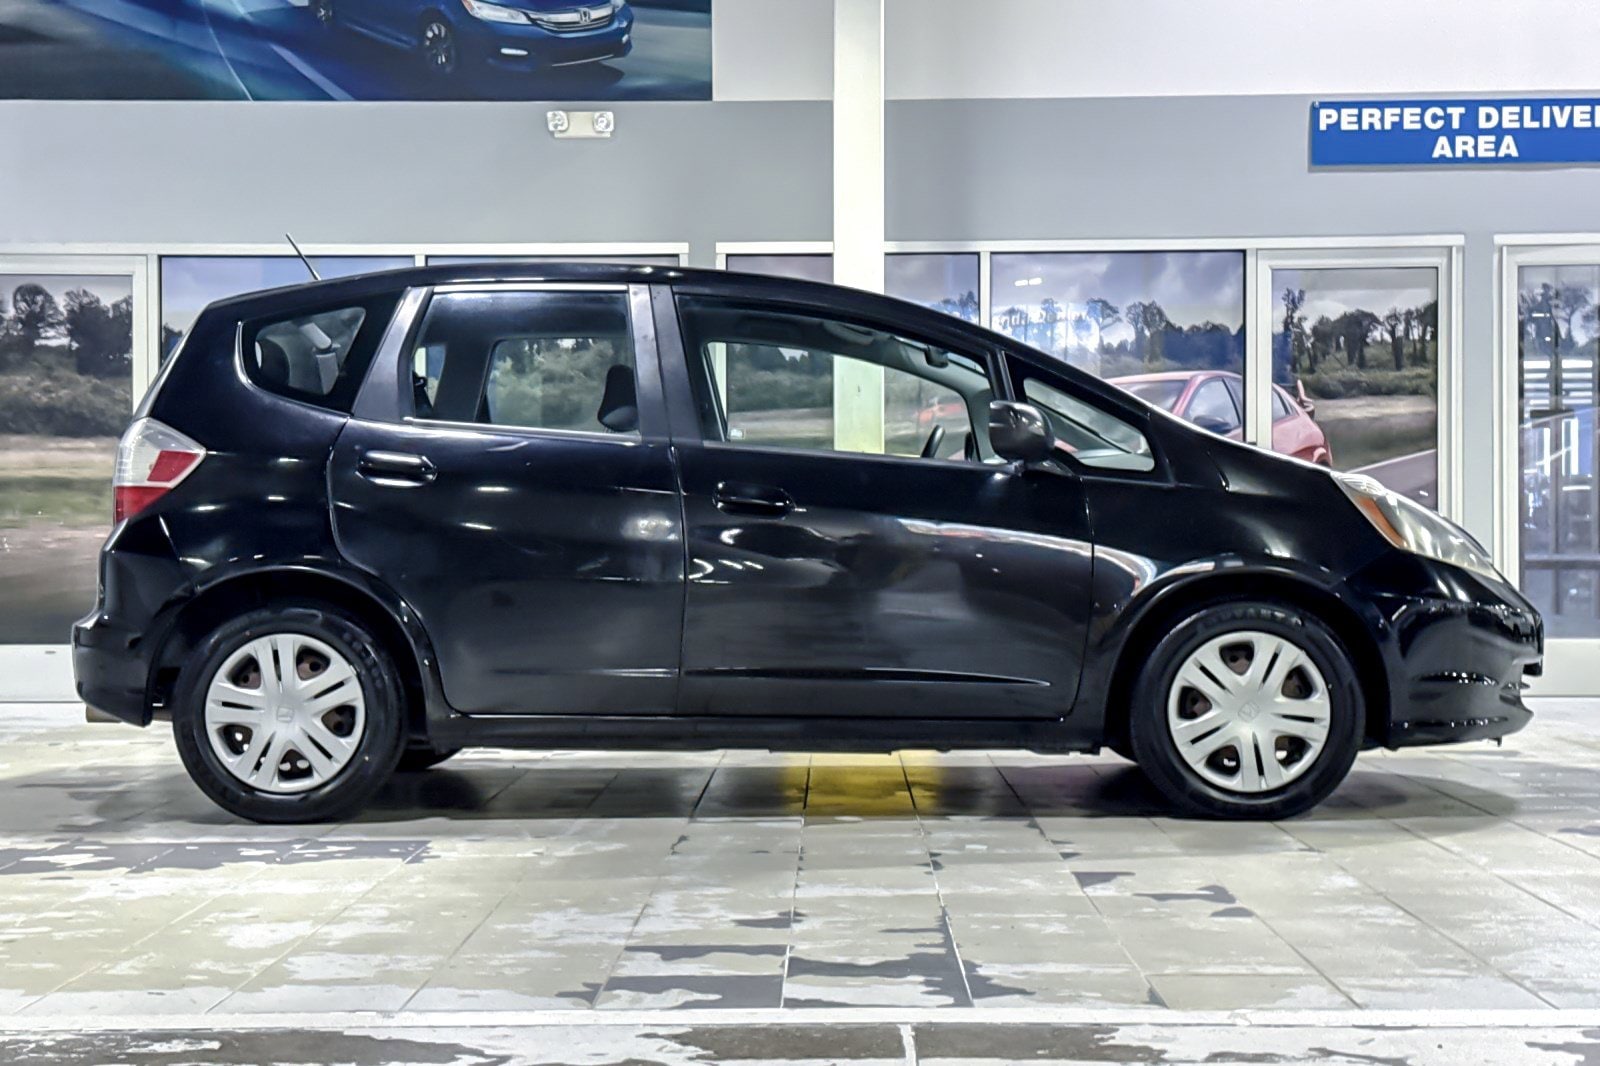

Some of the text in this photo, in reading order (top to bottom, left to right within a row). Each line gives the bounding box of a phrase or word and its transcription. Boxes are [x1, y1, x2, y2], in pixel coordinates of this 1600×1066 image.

[1318, 105, 1600, 131] PERFECT DELIVE
[1431, 134, 1520, 158] AREA
